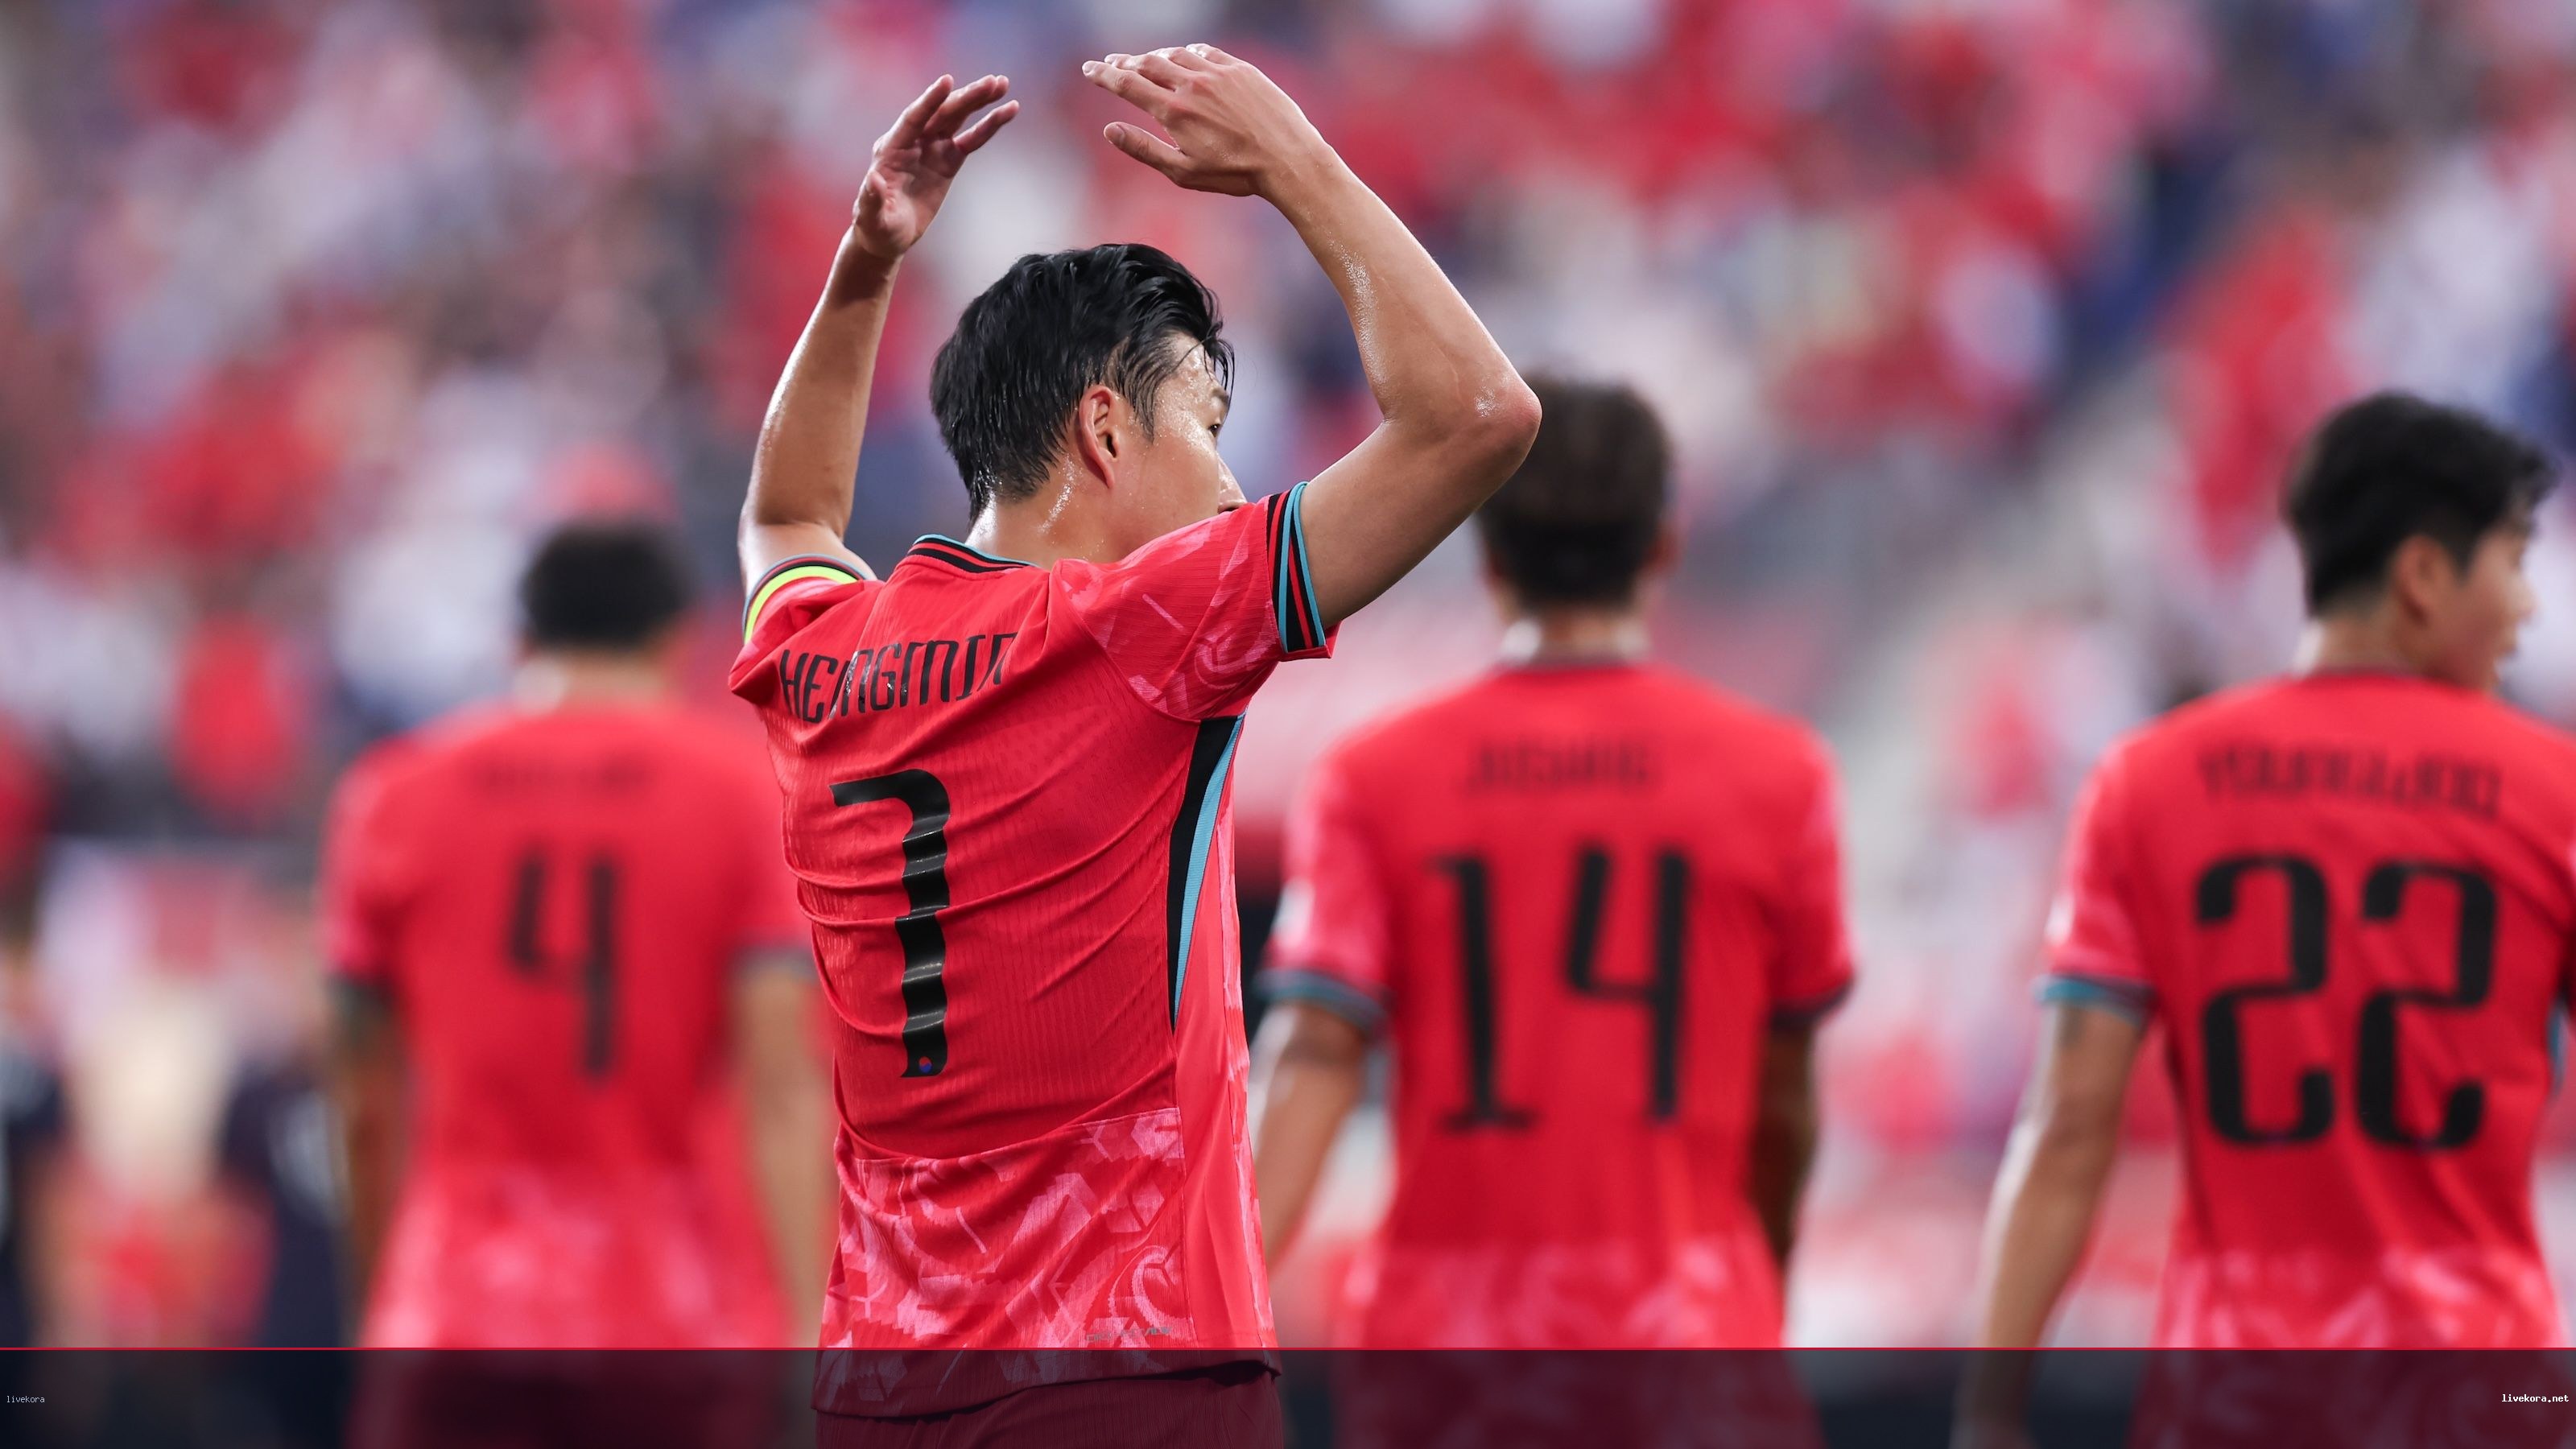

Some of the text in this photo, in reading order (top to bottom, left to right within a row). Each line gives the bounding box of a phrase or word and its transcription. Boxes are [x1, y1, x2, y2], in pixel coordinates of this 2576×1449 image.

[509, 840, 618, 1080] 4
[828, 768, 951, 1078] 7
[1431, 840, 1687, 1132] 14
[2194, 850, 2500, 1150] 22
